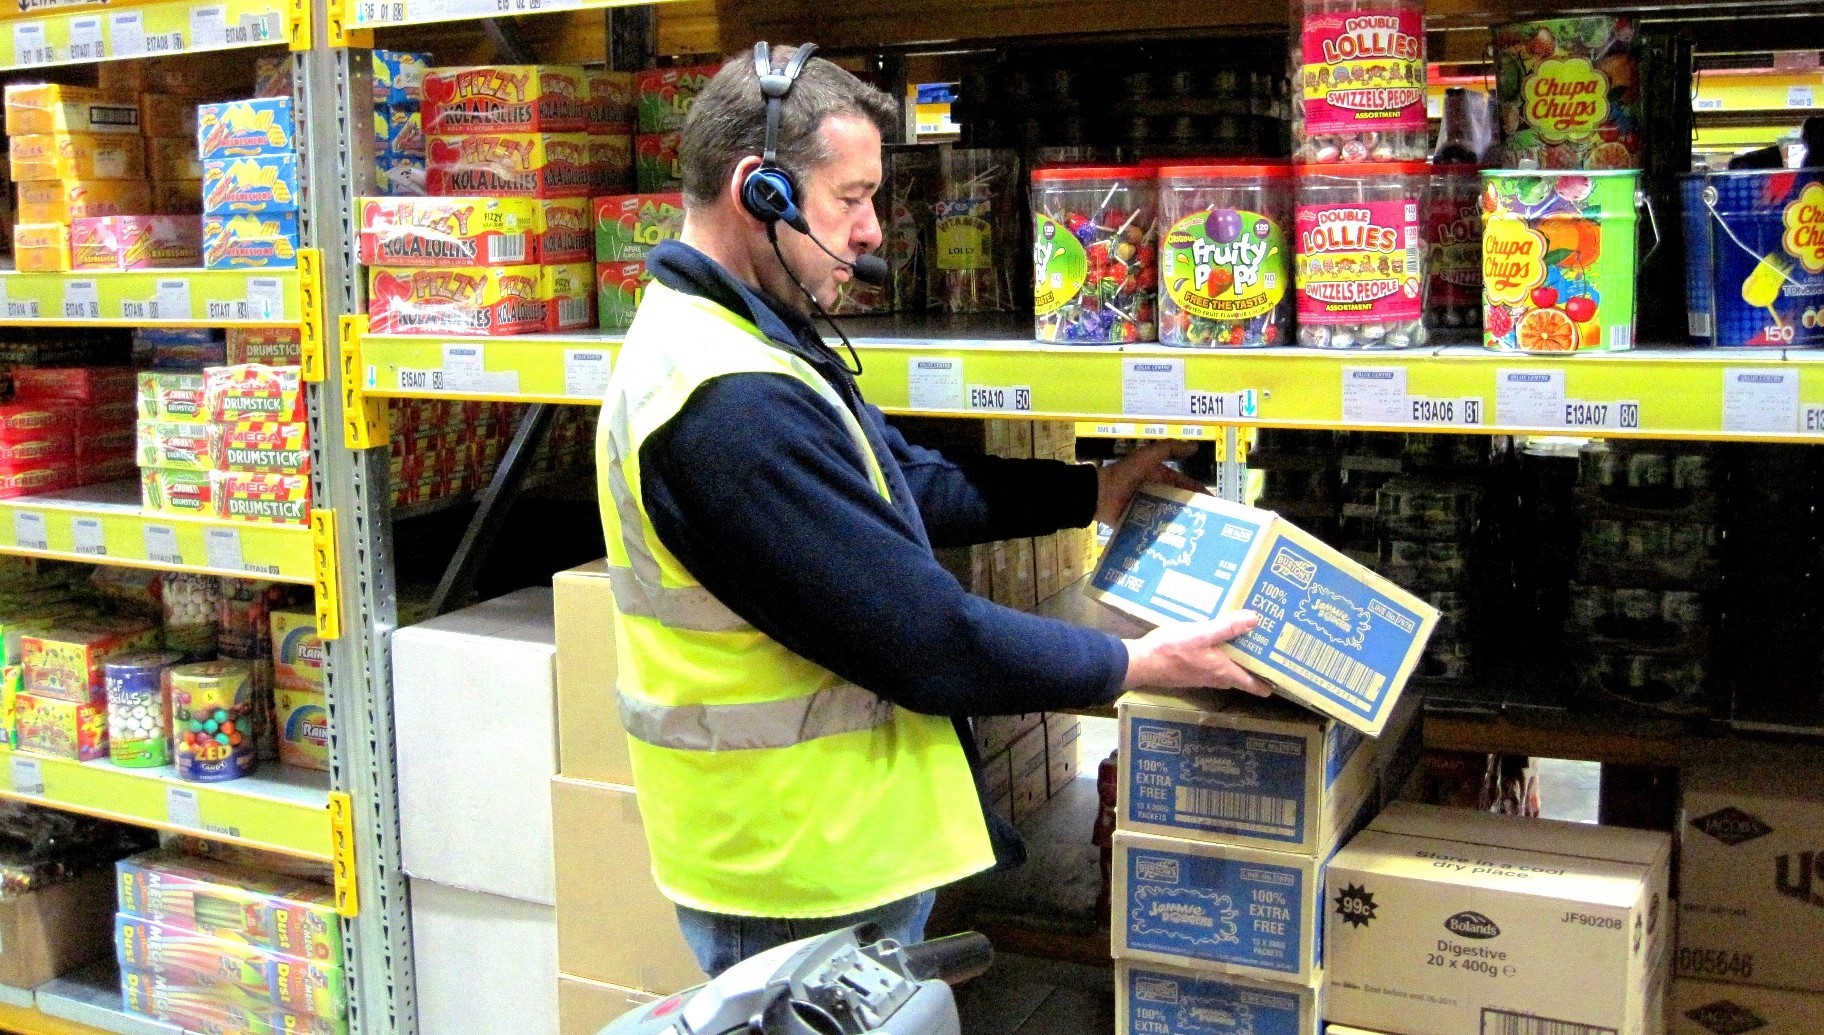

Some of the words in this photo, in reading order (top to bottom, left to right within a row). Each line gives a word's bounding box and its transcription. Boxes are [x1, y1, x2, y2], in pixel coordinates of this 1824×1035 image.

[1347, 16, 1399, 32] DOUBLE
[1323, 32, 1418, 63] LOLLIES
[456, 69, 531, 102] FIZZY
[1533, 78, 1598, 99] Chupa
[1327, 89, 1385, 109] SWIZZELS
[443, 101, 483, 124] KOLA
[485, 103, 533, 125] LOLLIES
[1354, 110, 1402, 119] ASSORTMENT
[1532, 97, 1597, 122] Chups
[462, 136, 536, 170] FIZZY
[451, 170, 489, 191] KOLA
[484, 212, 503, 223] FIZZY
[1255, 222, 1269, 231] 120
[1319, 209, 1370, 224] DOUBLE
[1303, 225, 1398, 255] LOLLIES
[1405, 227, 1417, 236] 120
[948, 246, 975, 255] LOLLY
[1486, 235, 1533, 260] Chupa
[1485, 258, 1531, 284] Chups
[413, 270, 489, 306] FIZZY
[499, 274, 538, 299] FIZZY
[1305, 281, 1354, 302] SWIZZELS
[1356, 280, 1397, 302] PEOPLE
[1184, 291, 1210, 308] FREE
[1211, 299, 1234, 311] THE
[1235, 292, 1268, 310] TASTE!
[1325, 303, 1373, 312] ASSORTMENT
[1764, 326, 1793, 342] 150
[401, 371, 427, 389] E15A07
[224, 397, 281, 410] DRUMSTICK
[971, 389, 1004, 408] E15A10
[1016, 389, 1029, 410] 50
[1190, 395, 1224, 415] E15A11
[1413, 400, 1454, 421] E13A06
[1465, 400, 1479, 424] 81
[1565, 404, 1608, 425] E13A07
[1620, 403, 1638, 428] 80
[229, 431, 282, 444] MEGA
[228, 449, 299, 466] DRUMSTICK
[230, 481, 284, 494] MEGA
[230, 499, 302, 517] DRUMSTICK
[1260, 581, 1287, 605] 100%
[1251, 593, 1286, 621] EXTRA
[1370, 601, 1387, 615] LINE
[1256, 612, 1276, 633] REE
[195, 745, 232, 761] ZED
[1138, 759, 1168, 773] 100%
[1136, 774, 1172, 787] EXTRA
[1139, 786, 1168, 800] FREE
[1415, 850, 1469, 864] Store
[1476, 859, 1494, 868] in
[1515, 864, 1565, 876] cool
[1433, 861, 1467, 872] dry
[1472, 866, 1529, 879] place
[124, 873, 136, 911] DUST
[1251, 890, 1286, 905] 100%
[1250, 904, 1290, 921] EXTRA
[1343, 896, 1371, 916] 99c
[276, 909, 291, 949] DUST
[1254, 919, 1285, 936] FREE
[1450, 919, 1497, 936] Bolands
[1561, 911, 1623, 930] JF90208
[124, 925, 136, 963] DUST
[1262, 938, 1268, 947] X
[1437, 940, 1507, 961] Digestive
[1426, 953, 1445, 967] 20
[1449, 958, 1458, 968] x
[1462, 960, 1498, 978] 400g
[128, 973, 140, 1012] DUST
[278, 963, 291, 1002] DUST
[1383, 987, 1408, 998] before
[1136, 1007, 1166, 1021] 100%
[1135, 1021, 1170, 1034] EXTRA
